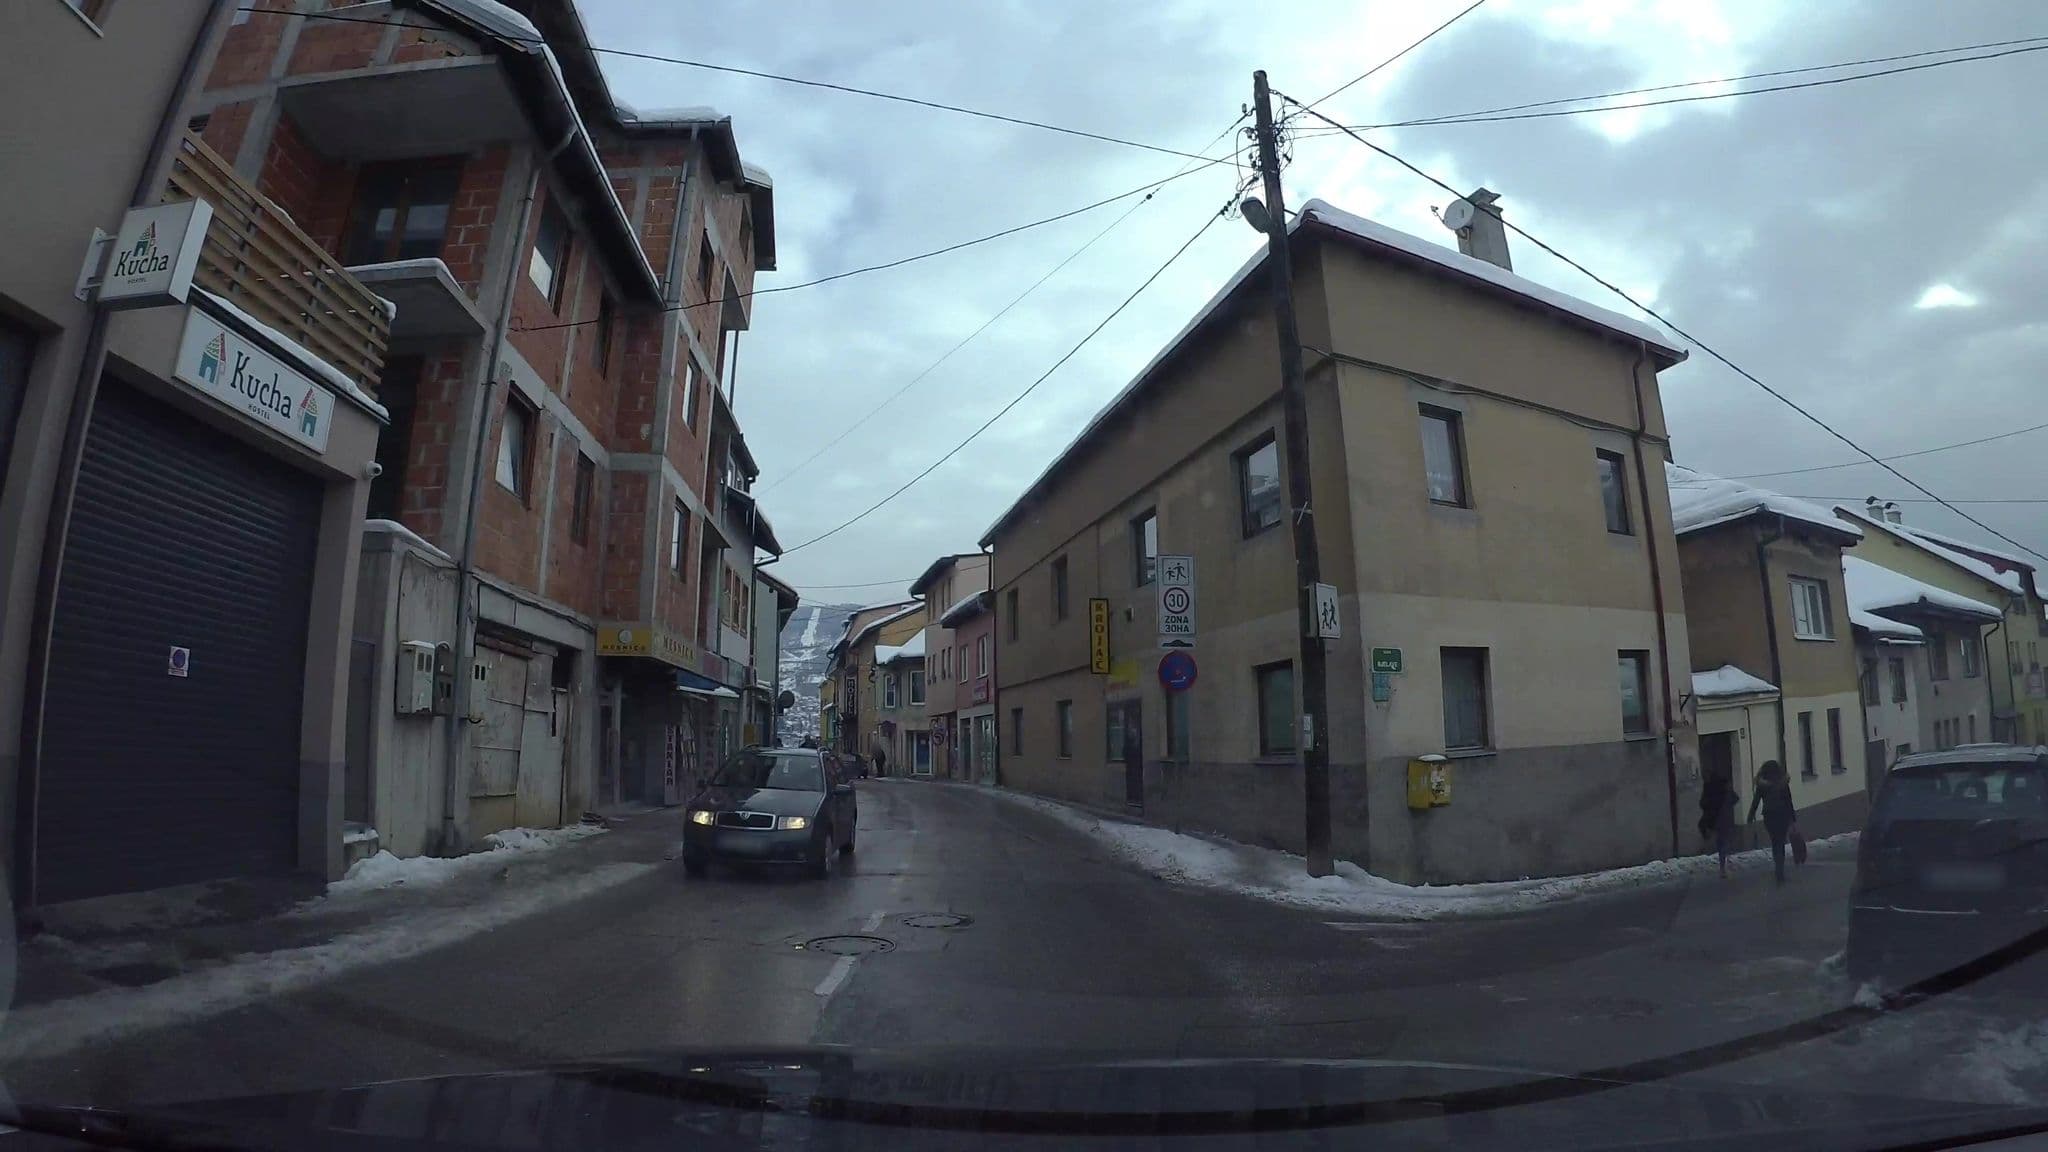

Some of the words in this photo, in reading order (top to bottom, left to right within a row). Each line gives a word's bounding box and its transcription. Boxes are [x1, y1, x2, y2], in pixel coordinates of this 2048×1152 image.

[113, 247, 169, 277] Kucha
[230, 350, 292, 419] Kucha
[247, 402, 271, 421] HOSTEL
[1168, 593, 1184, 608] 30
[1165, 615, 1189, 624] ZONA
